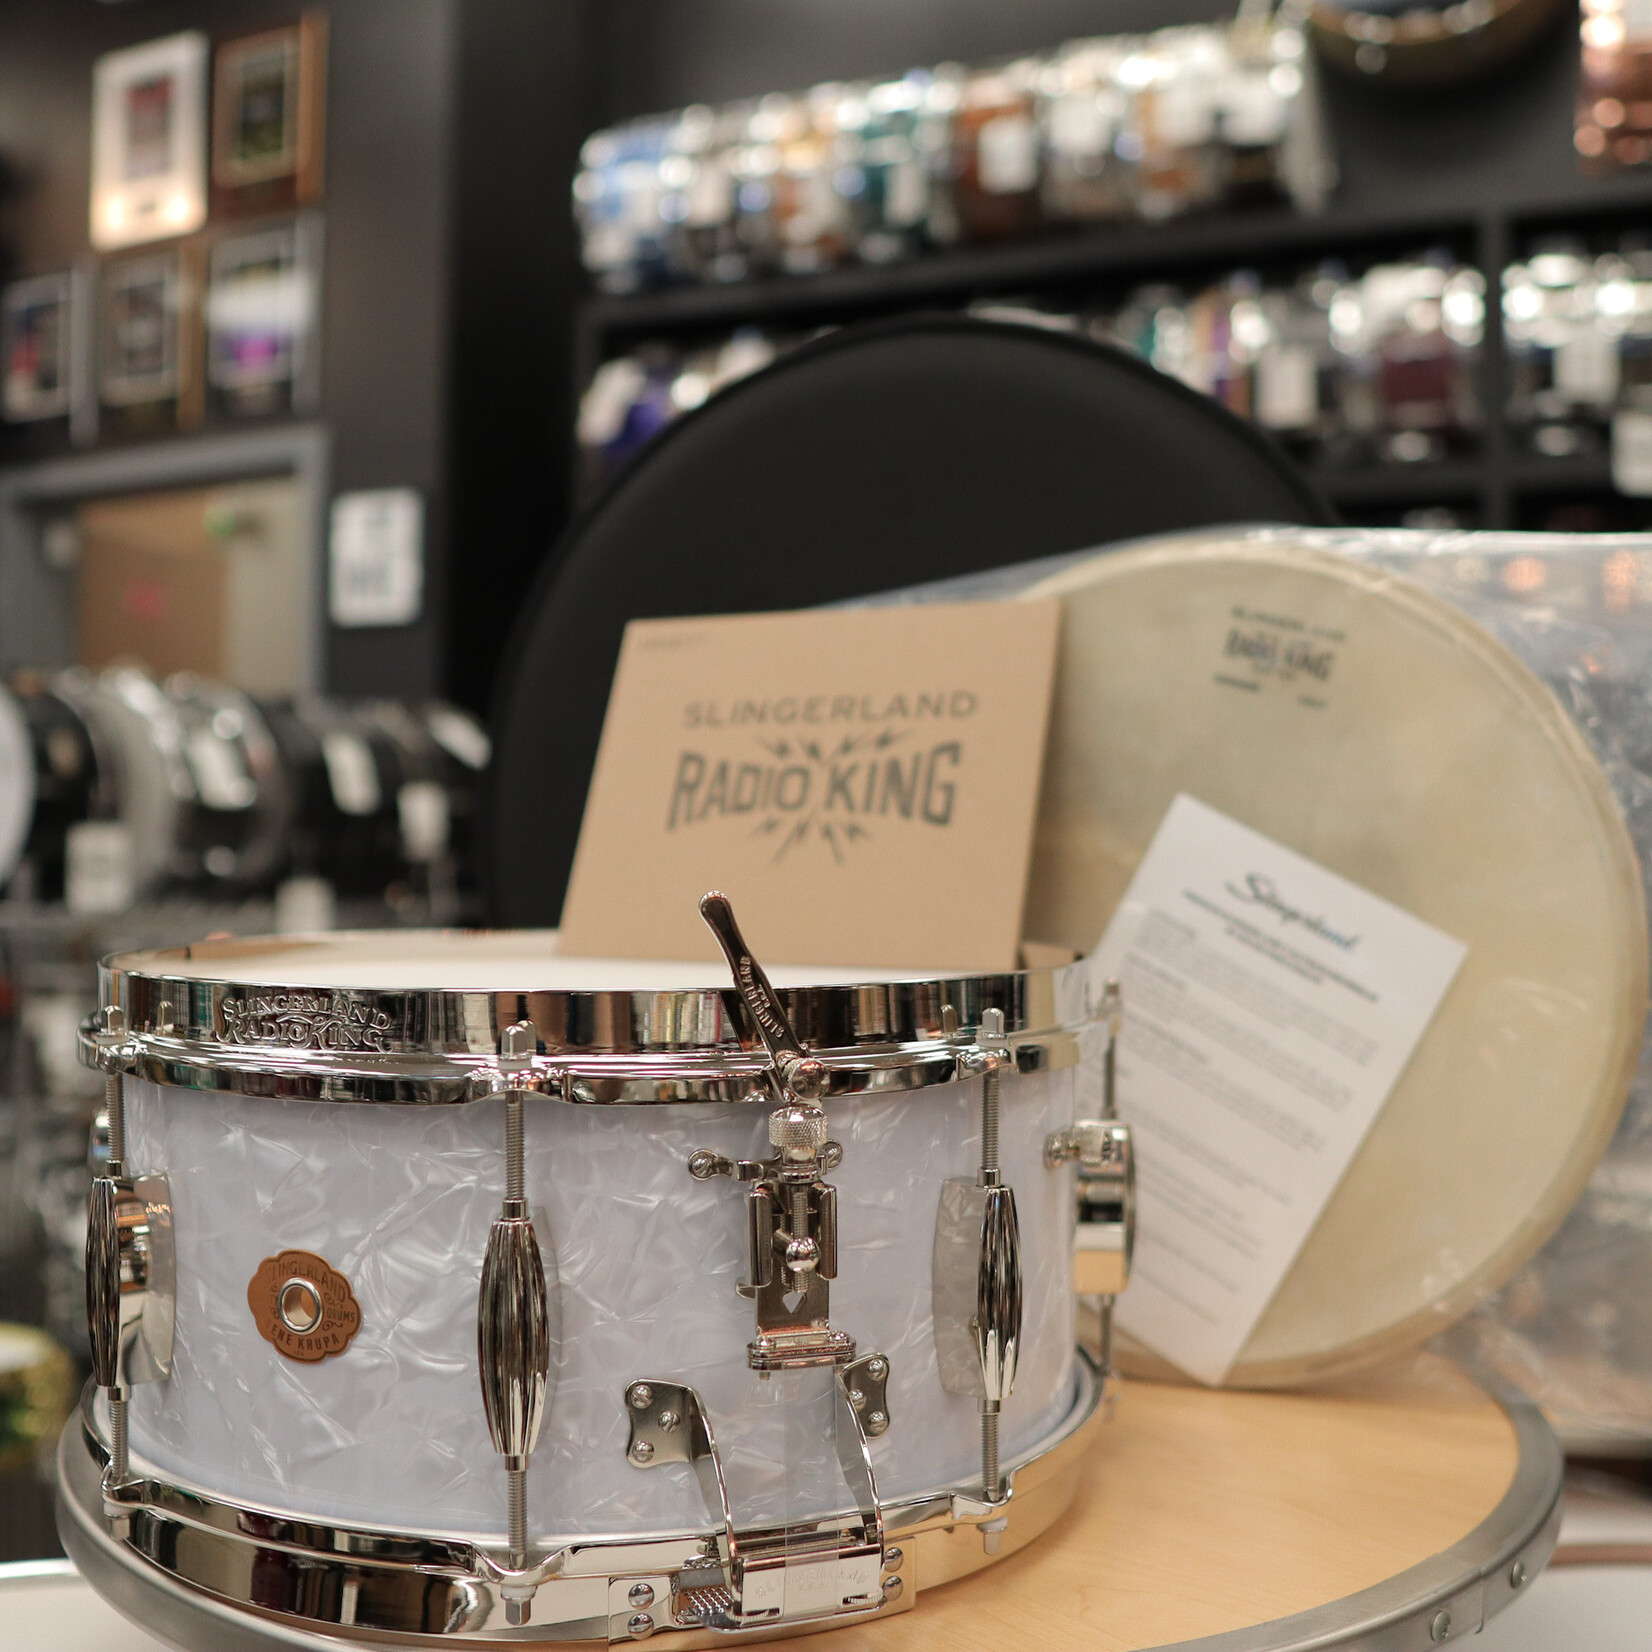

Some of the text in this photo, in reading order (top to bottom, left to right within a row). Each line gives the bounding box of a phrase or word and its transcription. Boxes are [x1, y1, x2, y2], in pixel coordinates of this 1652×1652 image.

[683, 690, 979, 729] SLINGERLAND
[664, 740, 963, 832] RADIO KING
[222, 994, 392, 1031] SLINGERLAND
[215, 1014, 393, 1055] RADIO KING
[270, 1260, 346, 1303] LINGERLAND
[270, 1323, 340, 1351] ENE KRUPA
